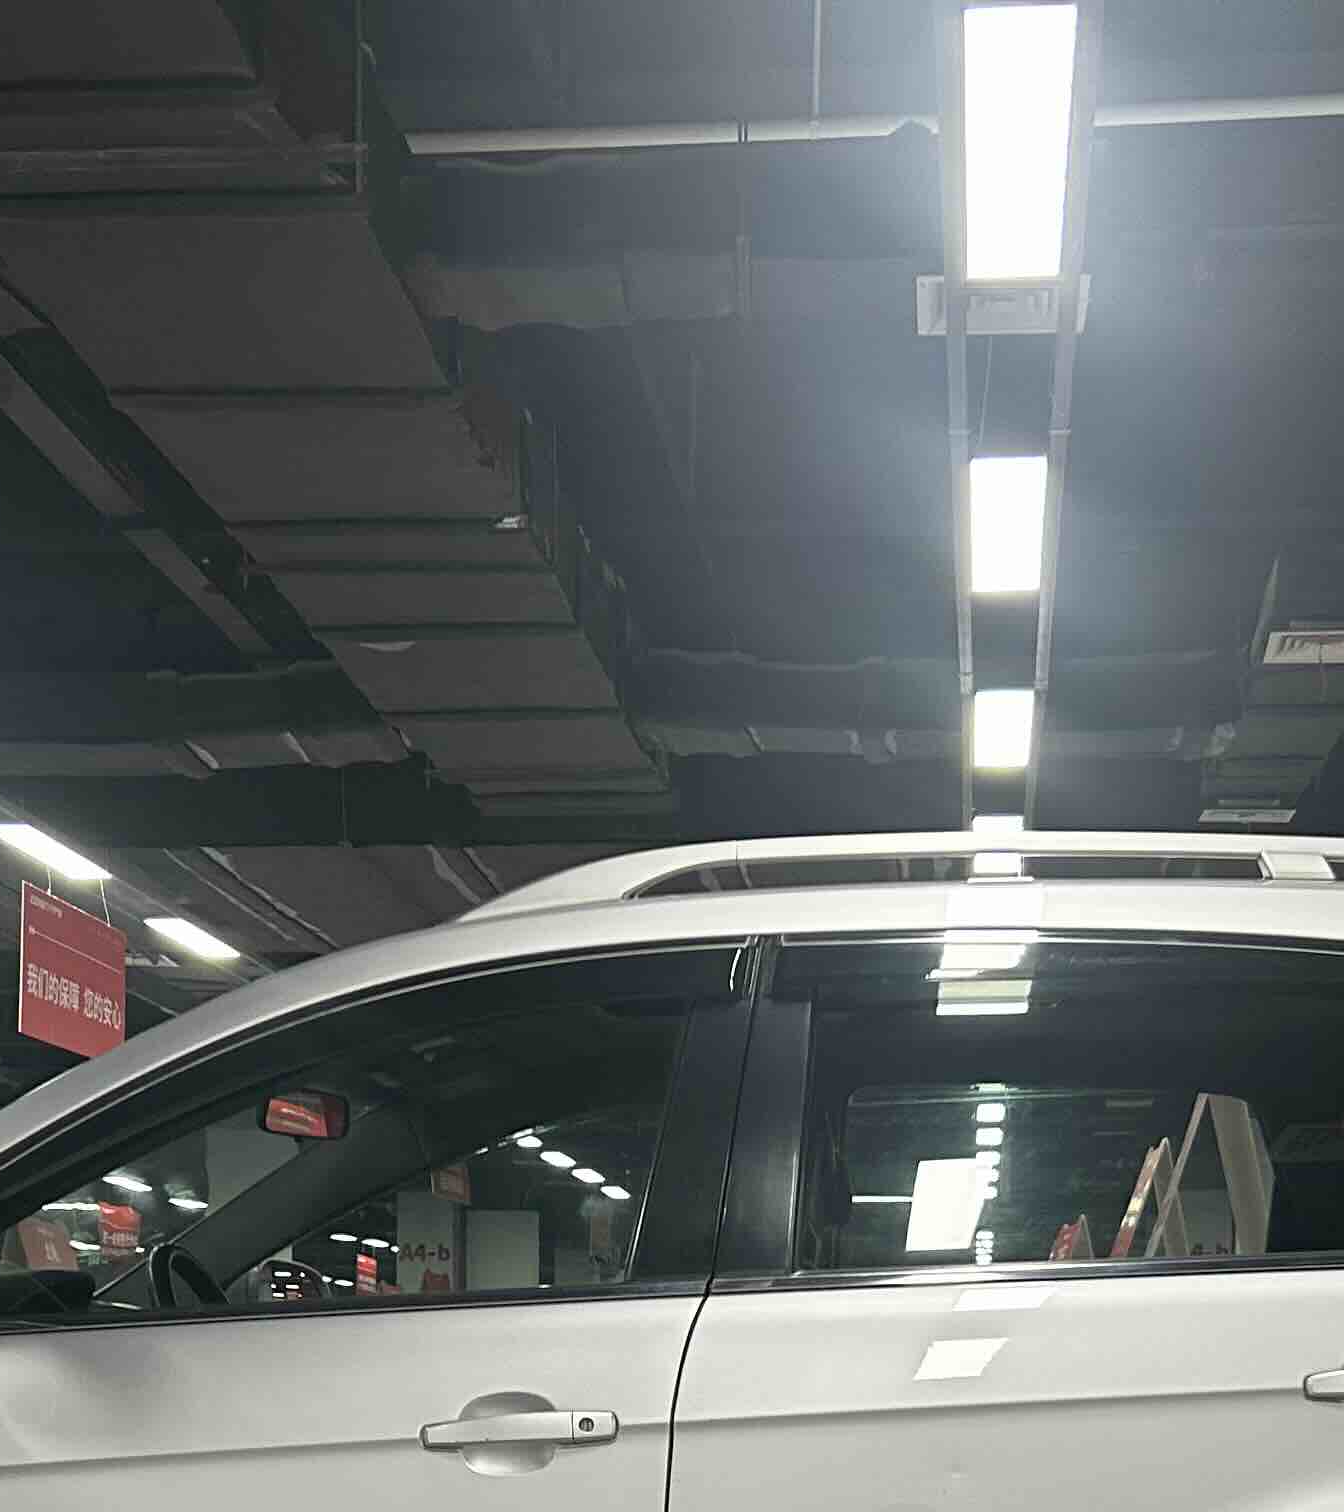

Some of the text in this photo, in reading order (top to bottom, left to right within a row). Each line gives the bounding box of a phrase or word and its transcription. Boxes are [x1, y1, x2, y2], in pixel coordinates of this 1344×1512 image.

[26, 962, 122, 1031] 我们的保障 您的安心
